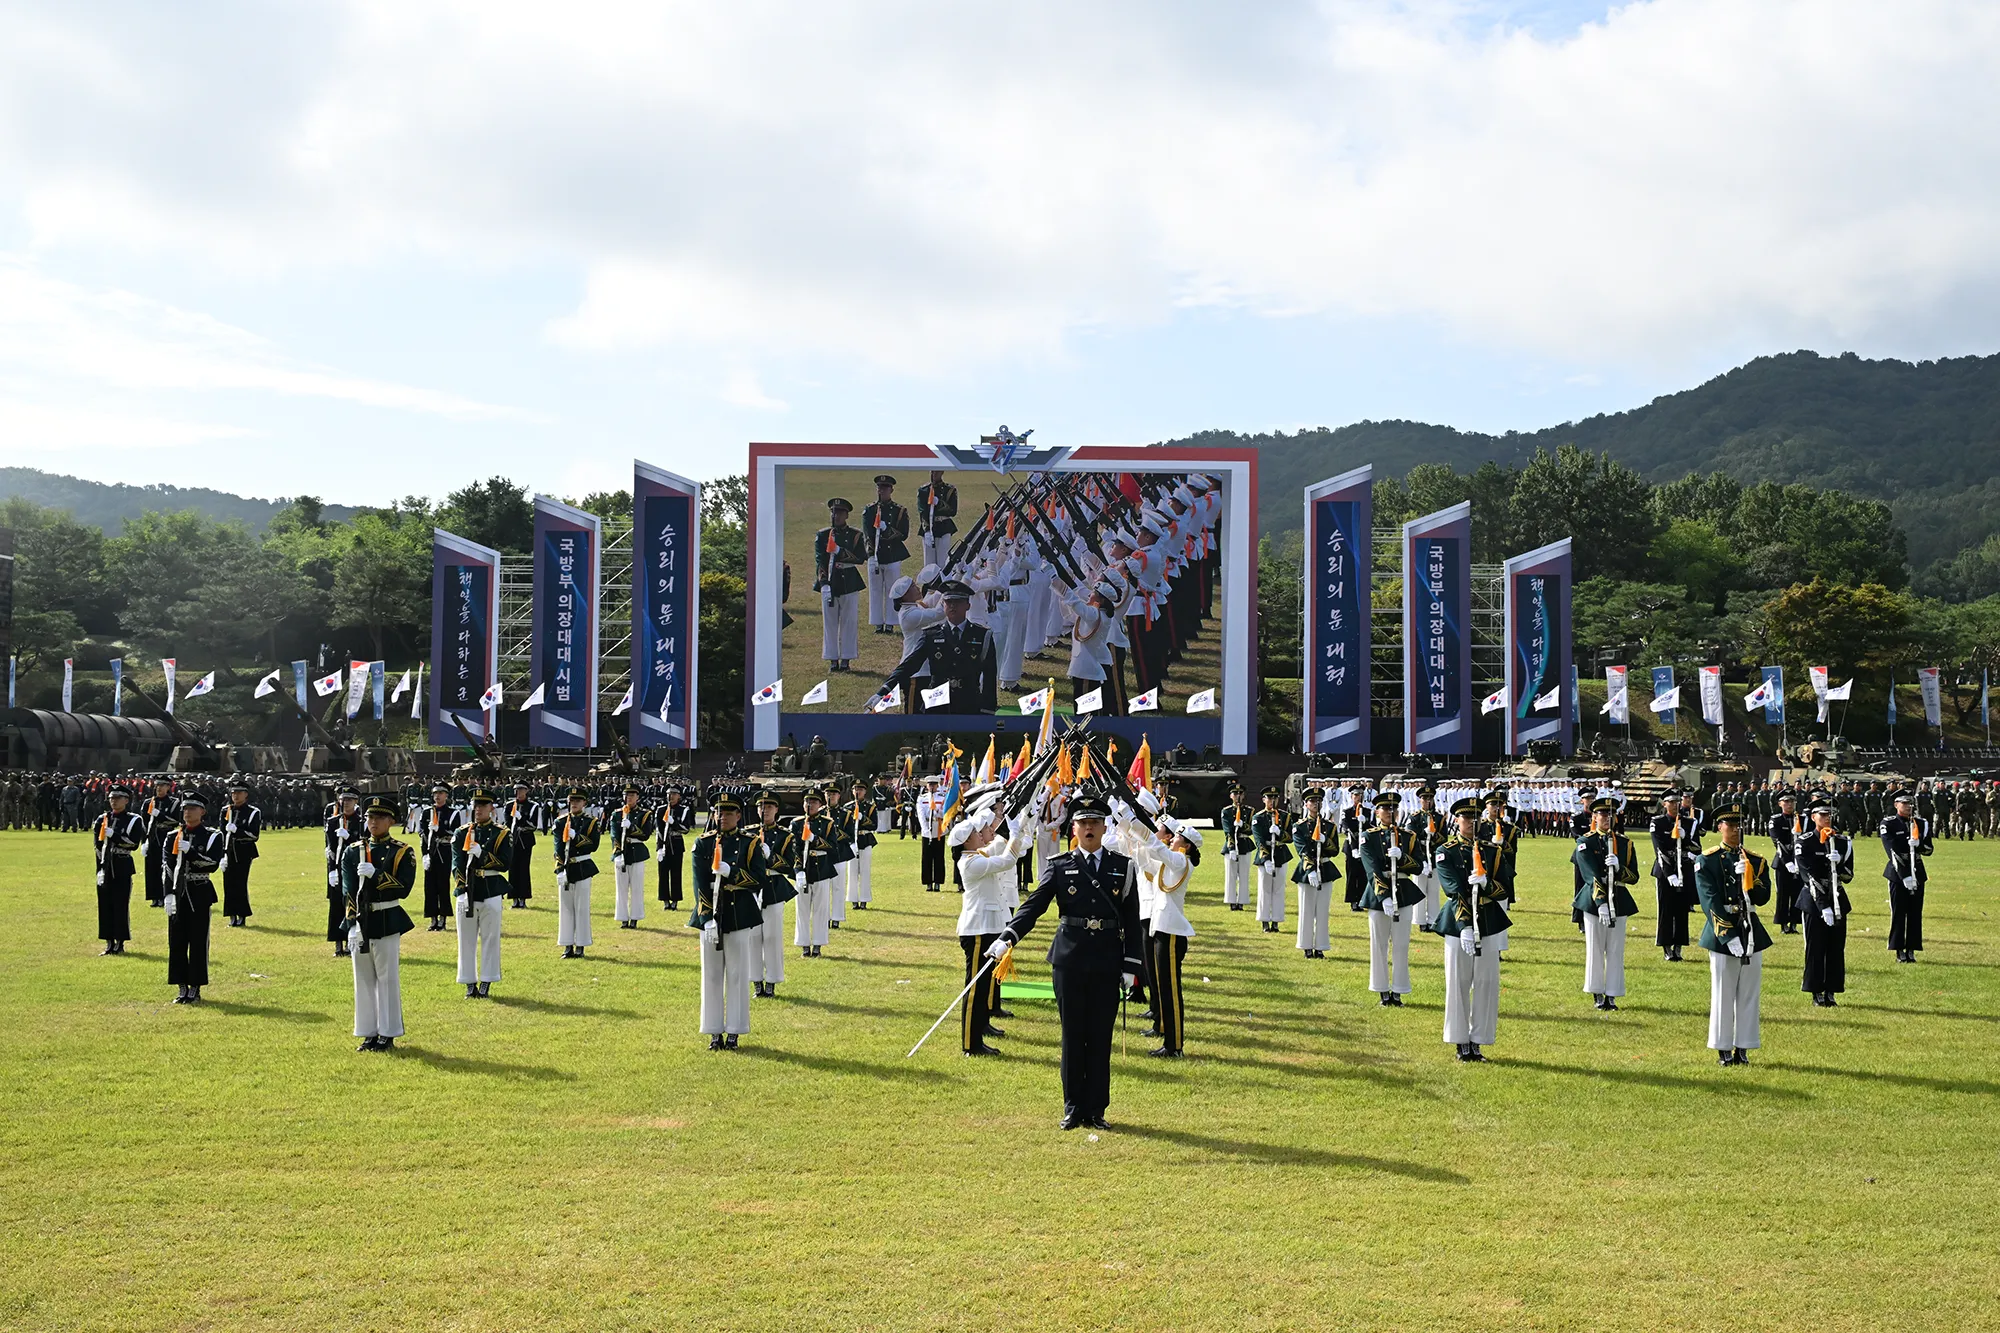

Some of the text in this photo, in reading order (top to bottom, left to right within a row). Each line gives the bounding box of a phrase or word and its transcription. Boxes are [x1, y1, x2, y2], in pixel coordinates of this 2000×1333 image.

[990, 441, 1017, 466] 77
[658, 524, 676, 594] 승리의
[556, 538, 575, 701] 국방부 의장대대 시범
[658, 603, 673, 626] 문
[1326, 529, 1345, 686] 승리의 문 대형
[1429, 545, 1445, 709] 국방부 의장대대 시범
[457, 629, 471, 679] 다하는
[655, 636, 675, 682] 대형
[1532, 636, 1544, 686] 다하는
[457, 686, 469, 701] 군
